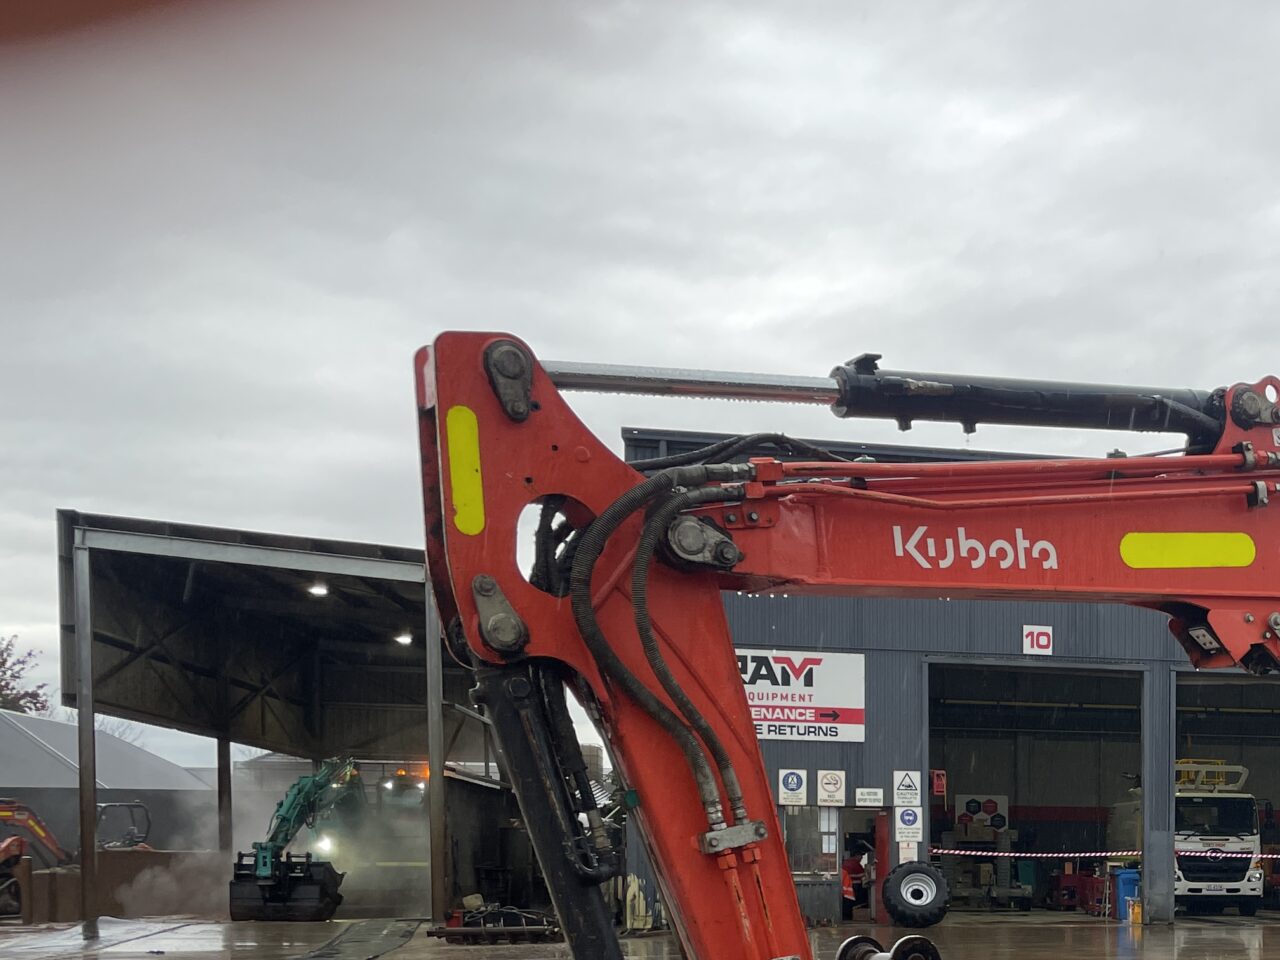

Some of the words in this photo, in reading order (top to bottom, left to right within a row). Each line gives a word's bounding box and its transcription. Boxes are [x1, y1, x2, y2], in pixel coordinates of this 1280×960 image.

[893, 525, 1058, 570] Kubota
[1025, 630, 1051, 650] 10
[748, 691, 814, 703] QUIPMENT
[768, 724, 839, 737] RETURNS
